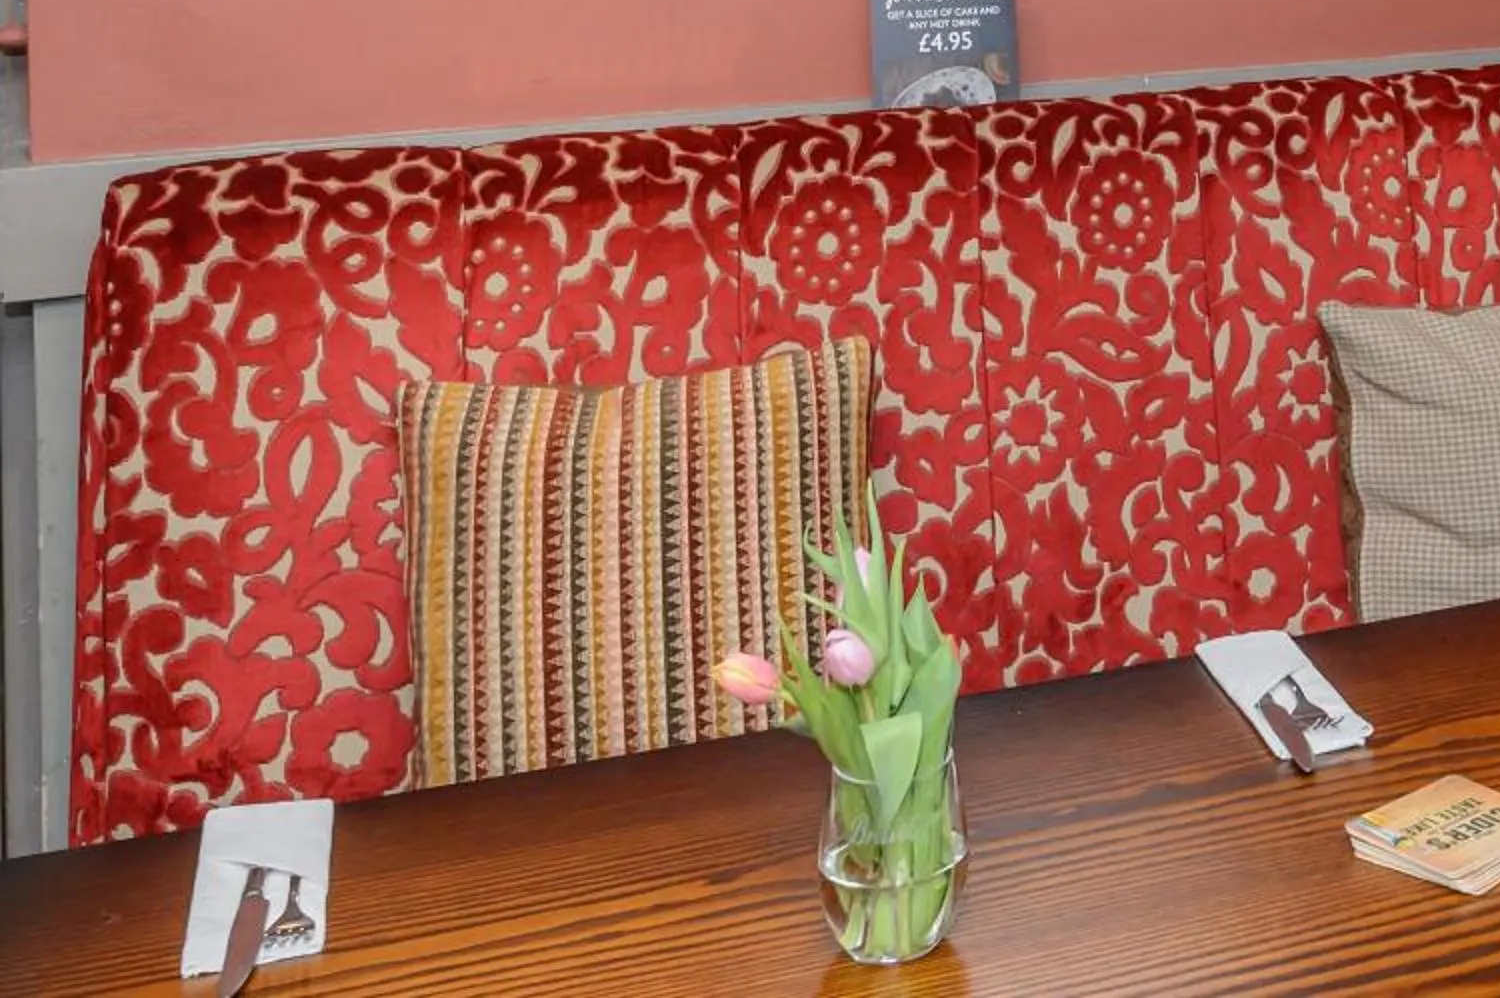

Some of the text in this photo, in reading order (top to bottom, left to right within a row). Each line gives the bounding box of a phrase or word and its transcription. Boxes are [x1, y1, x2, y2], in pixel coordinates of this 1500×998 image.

[887, 5, 1001, 20] GET A SLICE OF CAKE AND
[909, 17, 981, 29] ANY HOT DRINK
[918, 30, 973, 53] £4.95
